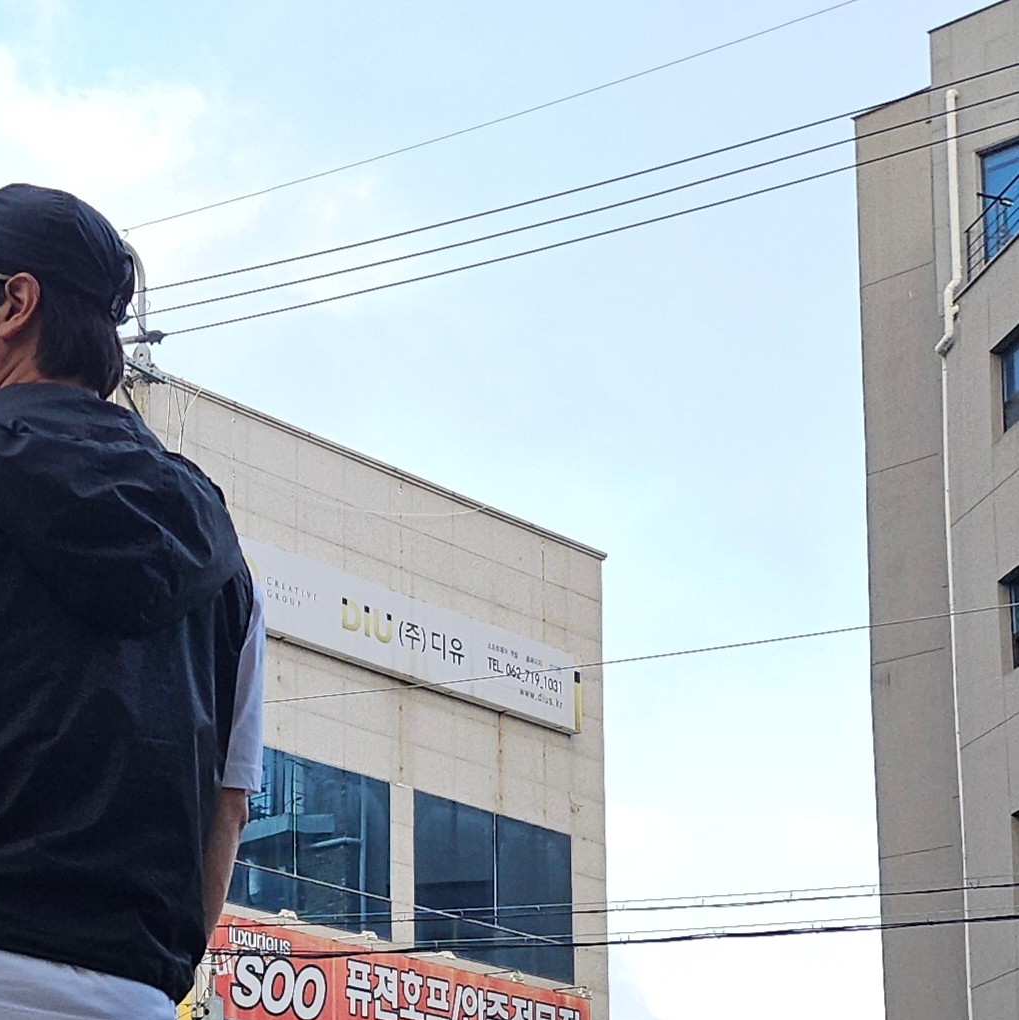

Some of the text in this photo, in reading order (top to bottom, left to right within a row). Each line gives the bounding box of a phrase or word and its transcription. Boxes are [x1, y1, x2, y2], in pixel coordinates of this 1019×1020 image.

[266, 576, 318, 602] CREATIVE
[266, 589, 302, 608] GROUP
[228, 926, 291, 955] luxurious
